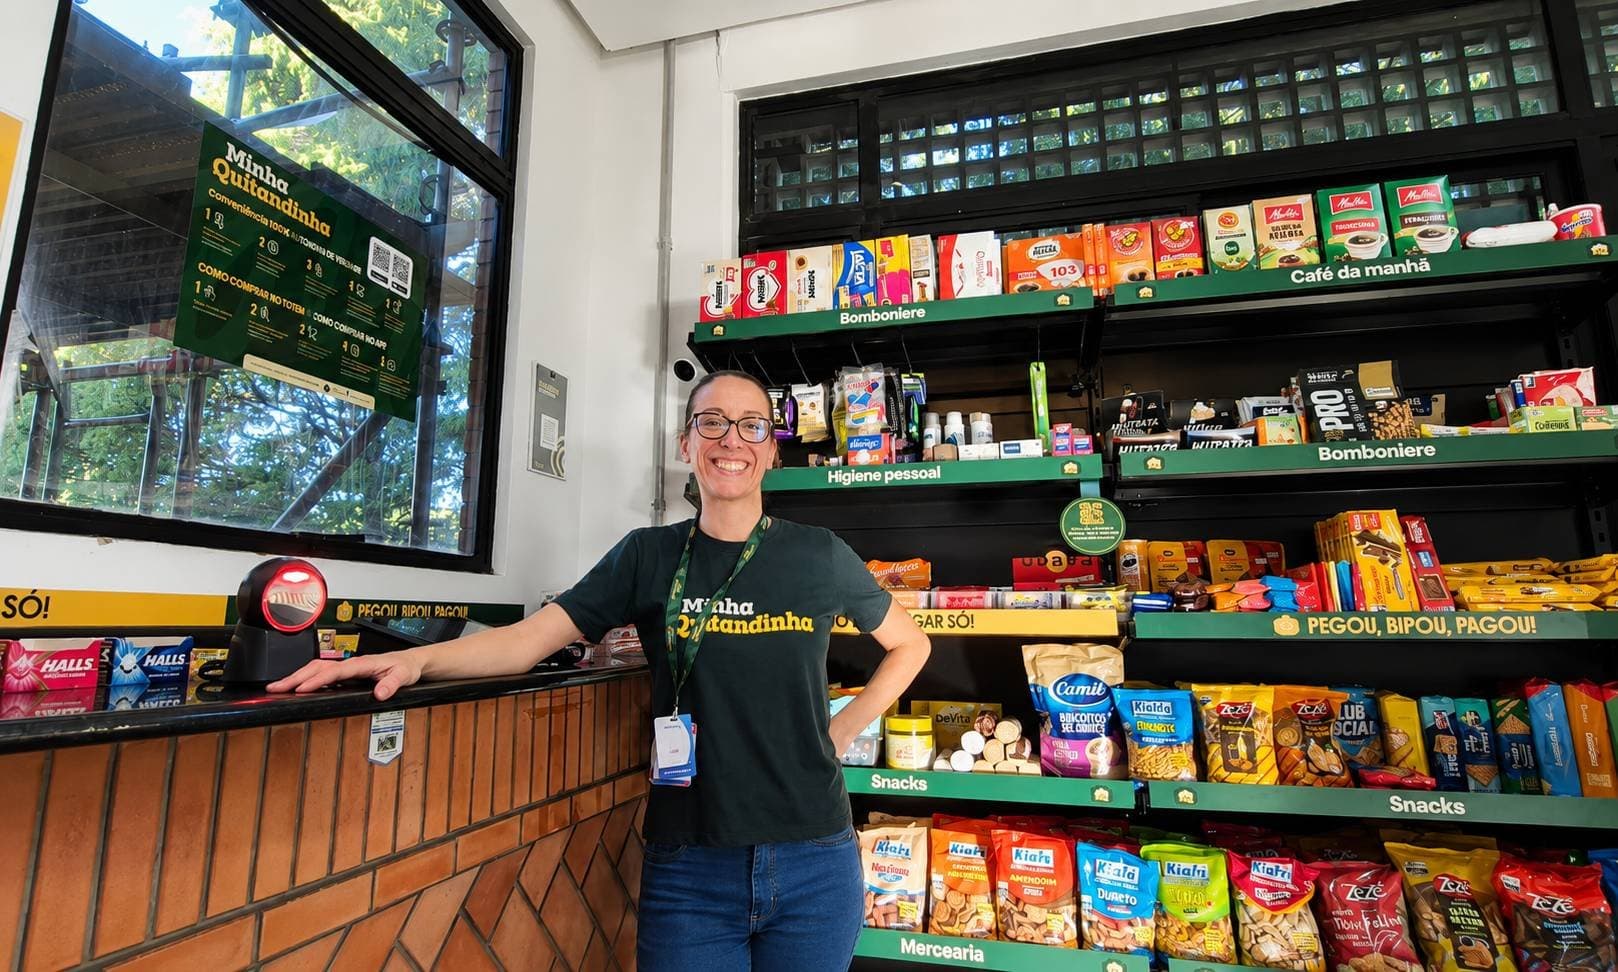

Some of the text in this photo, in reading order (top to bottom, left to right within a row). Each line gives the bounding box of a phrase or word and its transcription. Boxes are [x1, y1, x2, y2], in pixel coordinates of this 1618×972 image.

[225, 142, 288, 195] Minha
[212, 157, 330, 238] Quitandinha
[205, 207, 211, 220] 1
[259, 236, 265, 248] 2
[198, 262, 229, 282] COMO
[1050, 265, 1077, 278] 103
[1291, 260, 1431, 283] Café da manhã
[195, 280, 201, 294] 1
[250, 303, 257, 316] 2
[840, 306, 926, 325] Bomboniere
[312, 312, 334, 327] COMO
[1310, 389, 1355, 431] PRO
[1318, 443, 1436, 461] Bomboniere
[828, 466, 941, 485] Higiene pessoal
[1, 589, 50, 619] SÓ!
[676, 611, 815, 638] Qtandinha
[912, 610, 974, 629] GAR SÓ!
[1308, 615, 1537, 637] PEGOU, BIPOU, PAGOU!
[41, 657, 94, 672] HALLS
[143, 654, 186, 667] HALLS
[1055, 681, 1106, 697] Camil
[935, 713, 971, 725] DeVita
[1337, 704, 1365, 720] LUB
[871, 774, 928, 791] Snacks
[1389, 795, 1466, 815] Snacks
[1009, 874, 1057, 887] AMENDOIM
[900, 938, 985, 963] Mercearia
